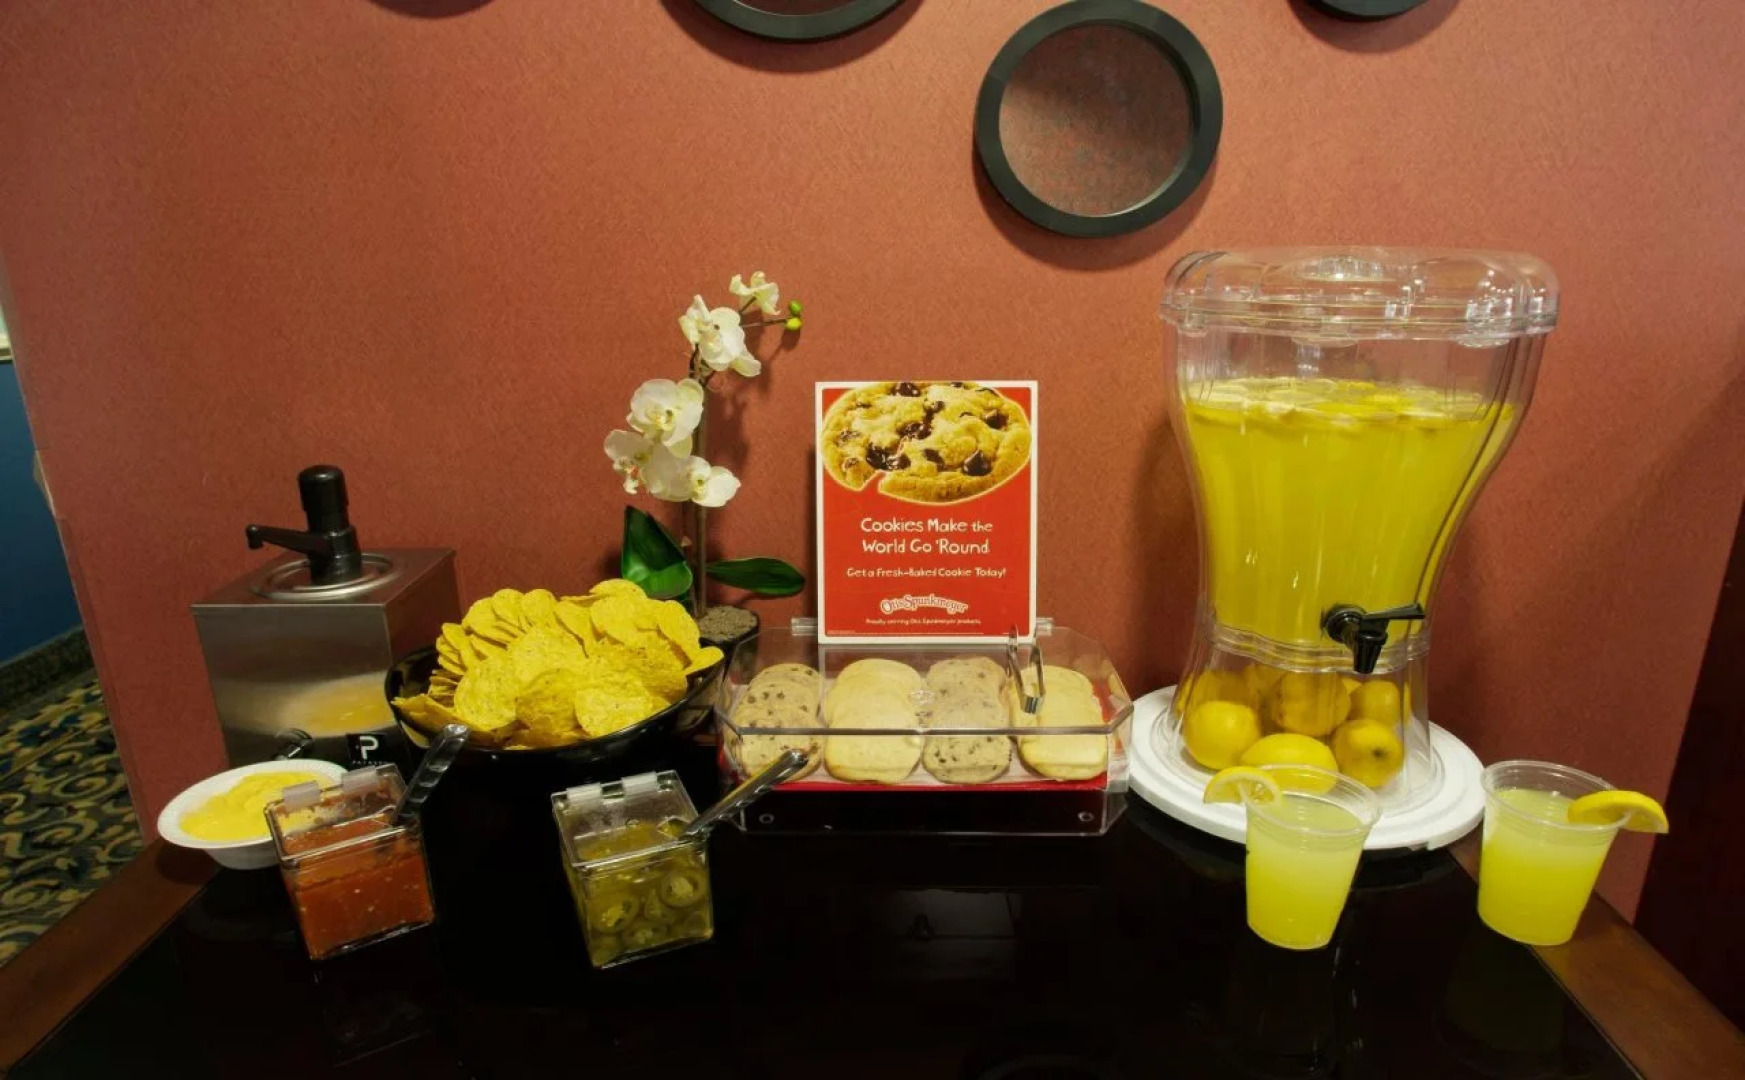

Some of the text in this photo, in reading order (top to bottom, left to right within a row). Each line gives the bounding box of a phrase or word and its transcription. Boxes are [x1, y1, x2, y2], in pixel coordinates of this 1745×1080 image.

[861, 517, 993, 533] Cookies Make the
[862, 538, 989, 554] World Go 'Round
[847, 567, 1006, 578] Get a Fresh-Baked Cookie Today!
